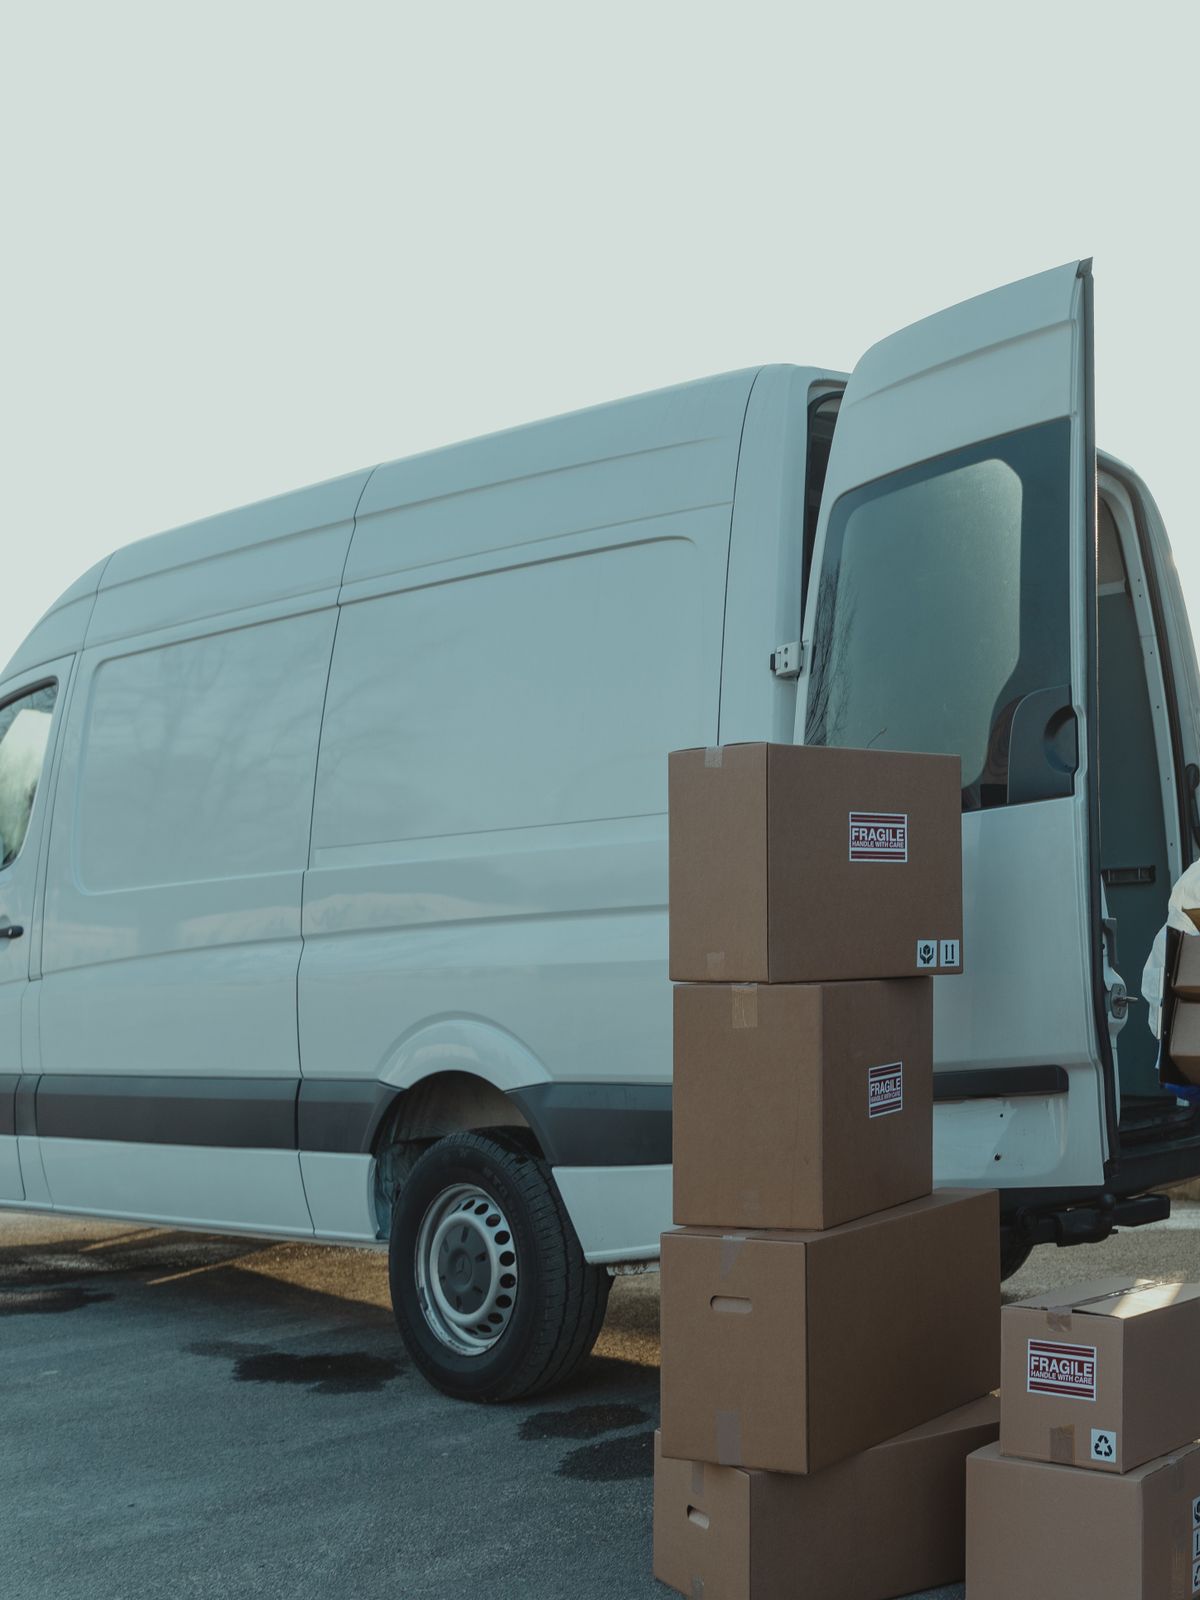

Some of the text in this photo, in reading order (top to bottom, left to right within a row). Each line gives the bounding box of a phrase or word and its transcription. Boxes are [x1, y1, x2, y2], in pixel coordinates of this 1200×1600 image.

[852, 828, 904, 841] FRAGILE
[871, 1078, 900, 1096] FRAGILE
[1031, 1356, 1092, 1377] FRAGILE
[1031, 1370, 1092, 1384] HANDLE WITH CARE
